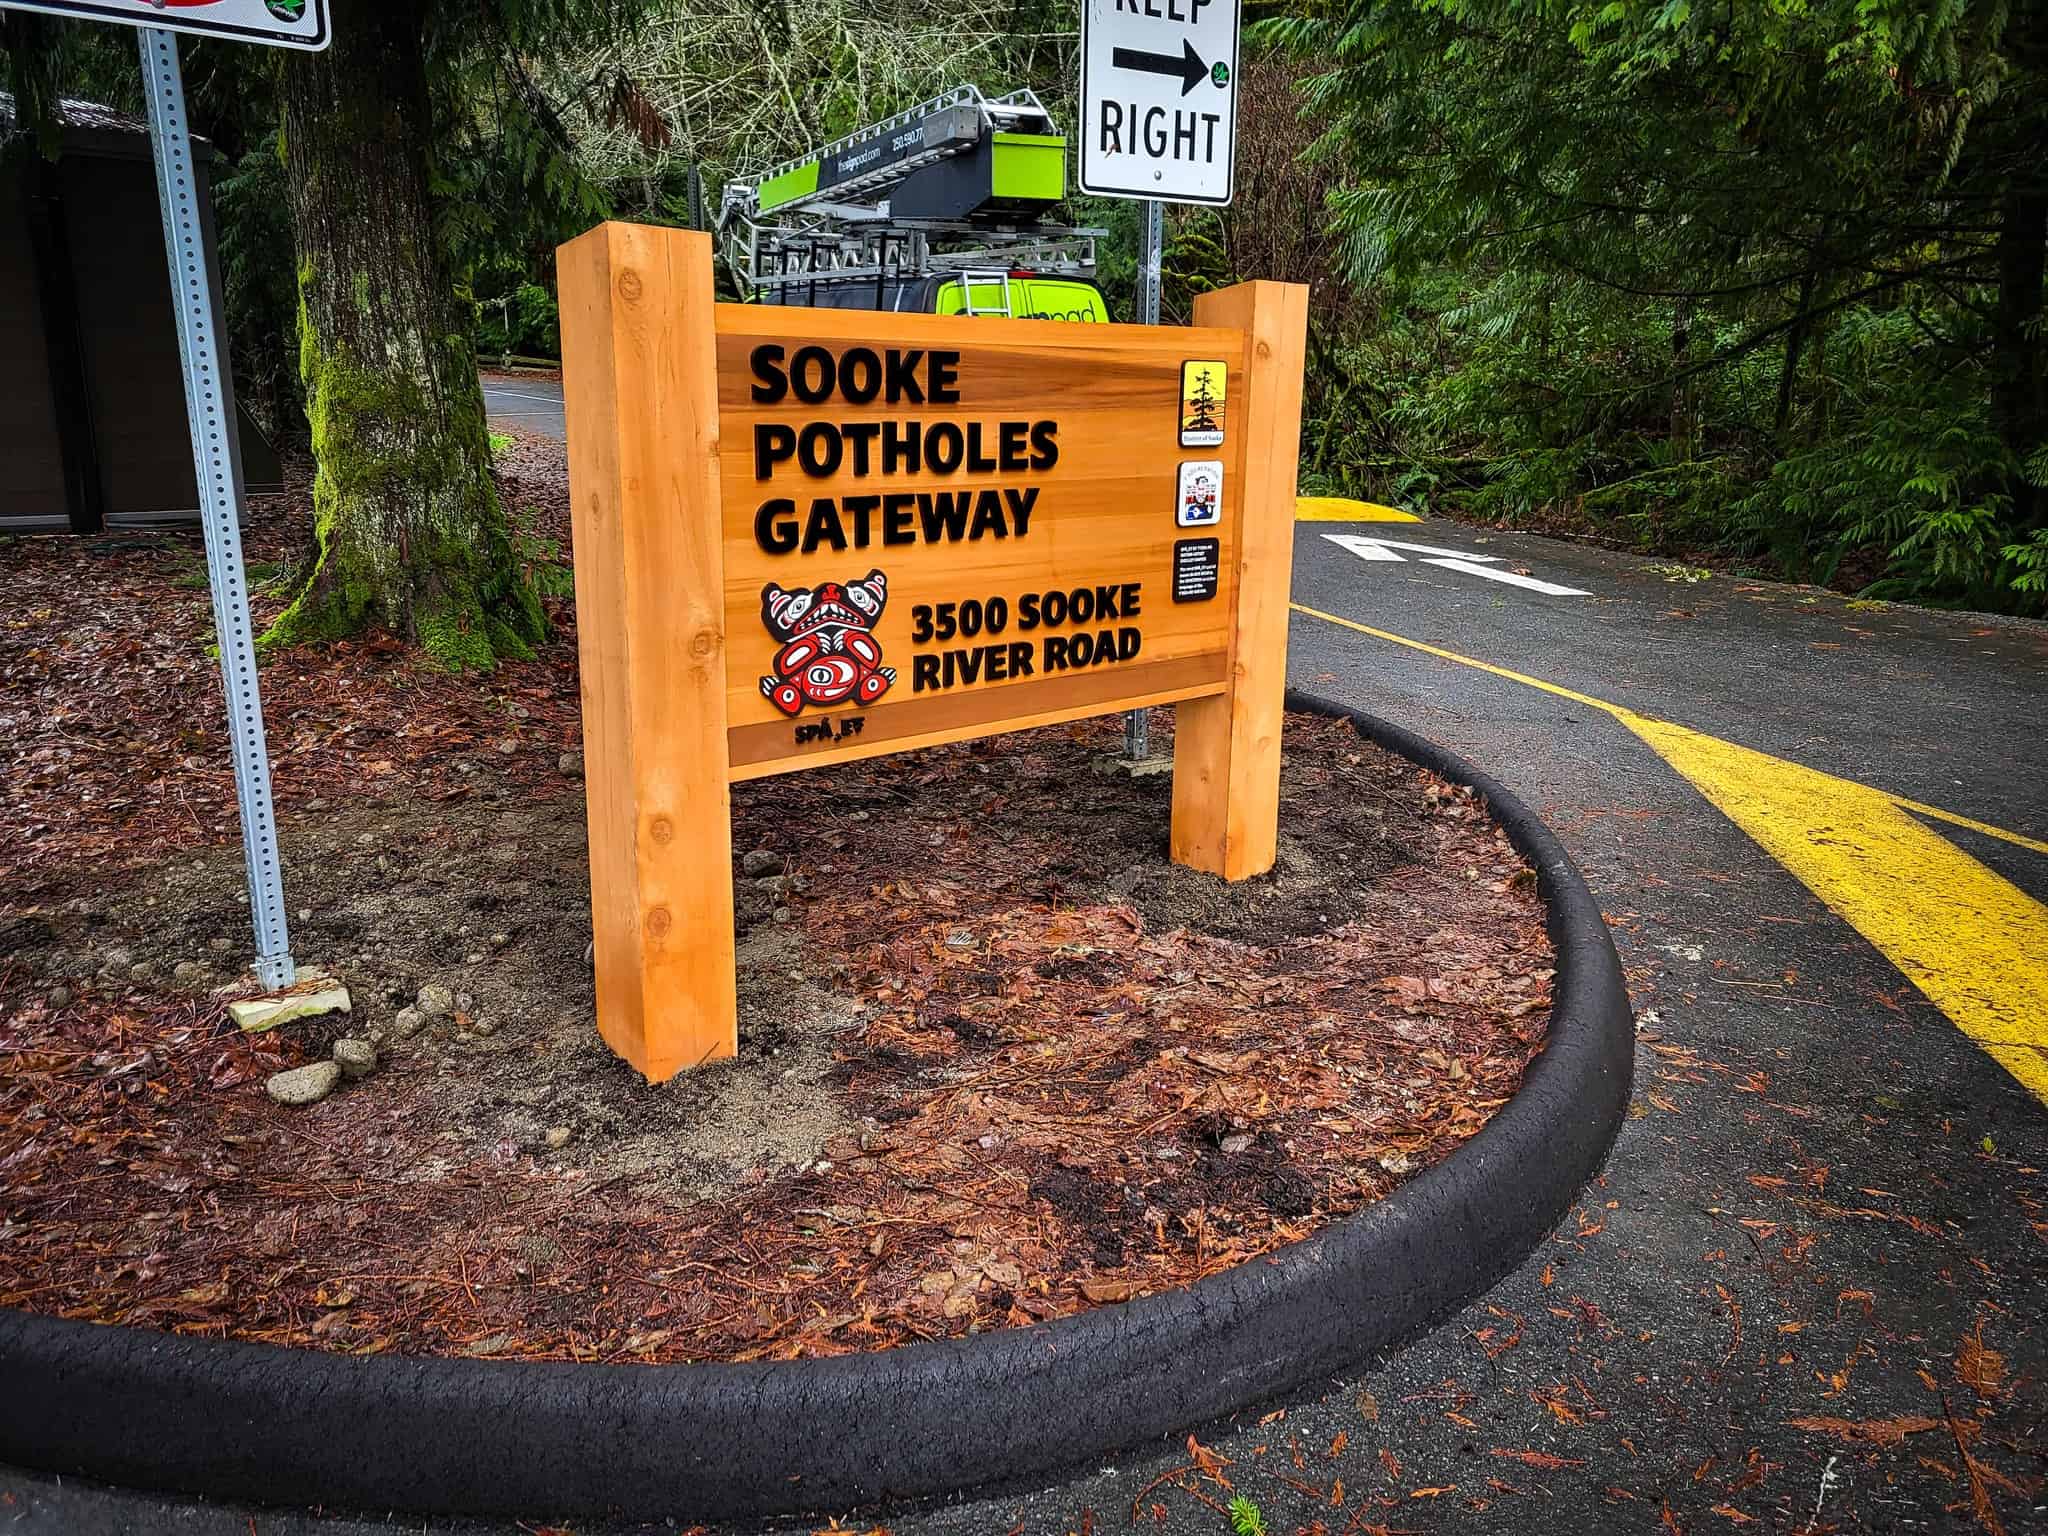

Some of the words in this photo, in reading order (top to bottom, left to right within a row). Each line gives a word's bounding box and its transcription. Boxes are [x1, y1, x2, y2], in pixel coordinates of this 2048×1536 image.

[1100, 99, 1221, 163] RIGHT
[750, 344, 961, 404] SOOKE
[754, 420, 1060, 481] POTHOLES
[754, 487, 1041, 555] GATEWAY
[912, 596, 1008, 643] 3500
[1018, 582, 1142, 631] SOOKE
[912, 641, 1035, 692] RIVER
[1043, 626, 1142, 673] ROAD
